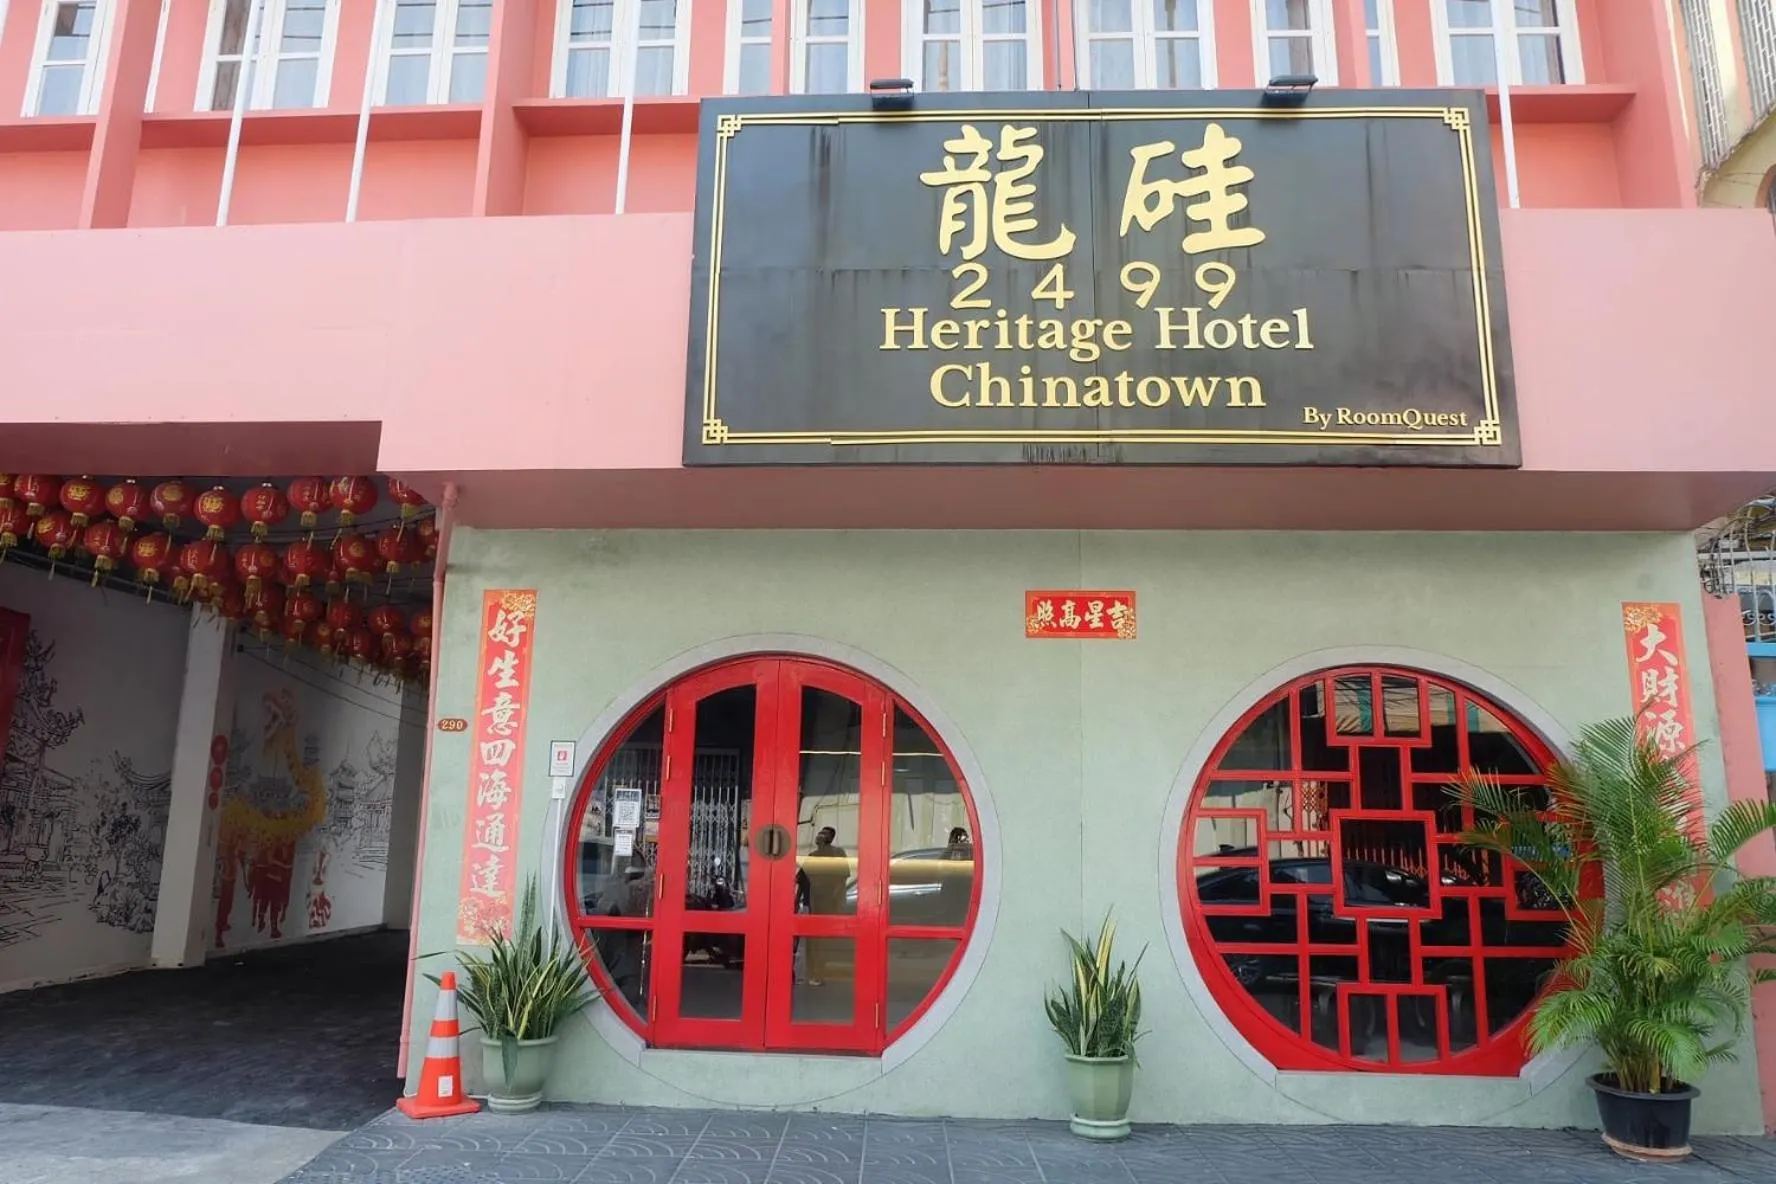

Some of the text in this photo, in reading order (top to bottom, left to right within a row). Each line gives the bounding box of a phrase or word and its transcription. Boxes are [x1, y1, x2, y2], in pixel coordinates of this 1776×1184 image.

[879, 306, 1314, 363] Heritage Hotel
[929, 361, 1267, 408] Chinatown
[1303, 406, 1469, 431] By RoomQuest
[442, 719, 464, 730] 290
